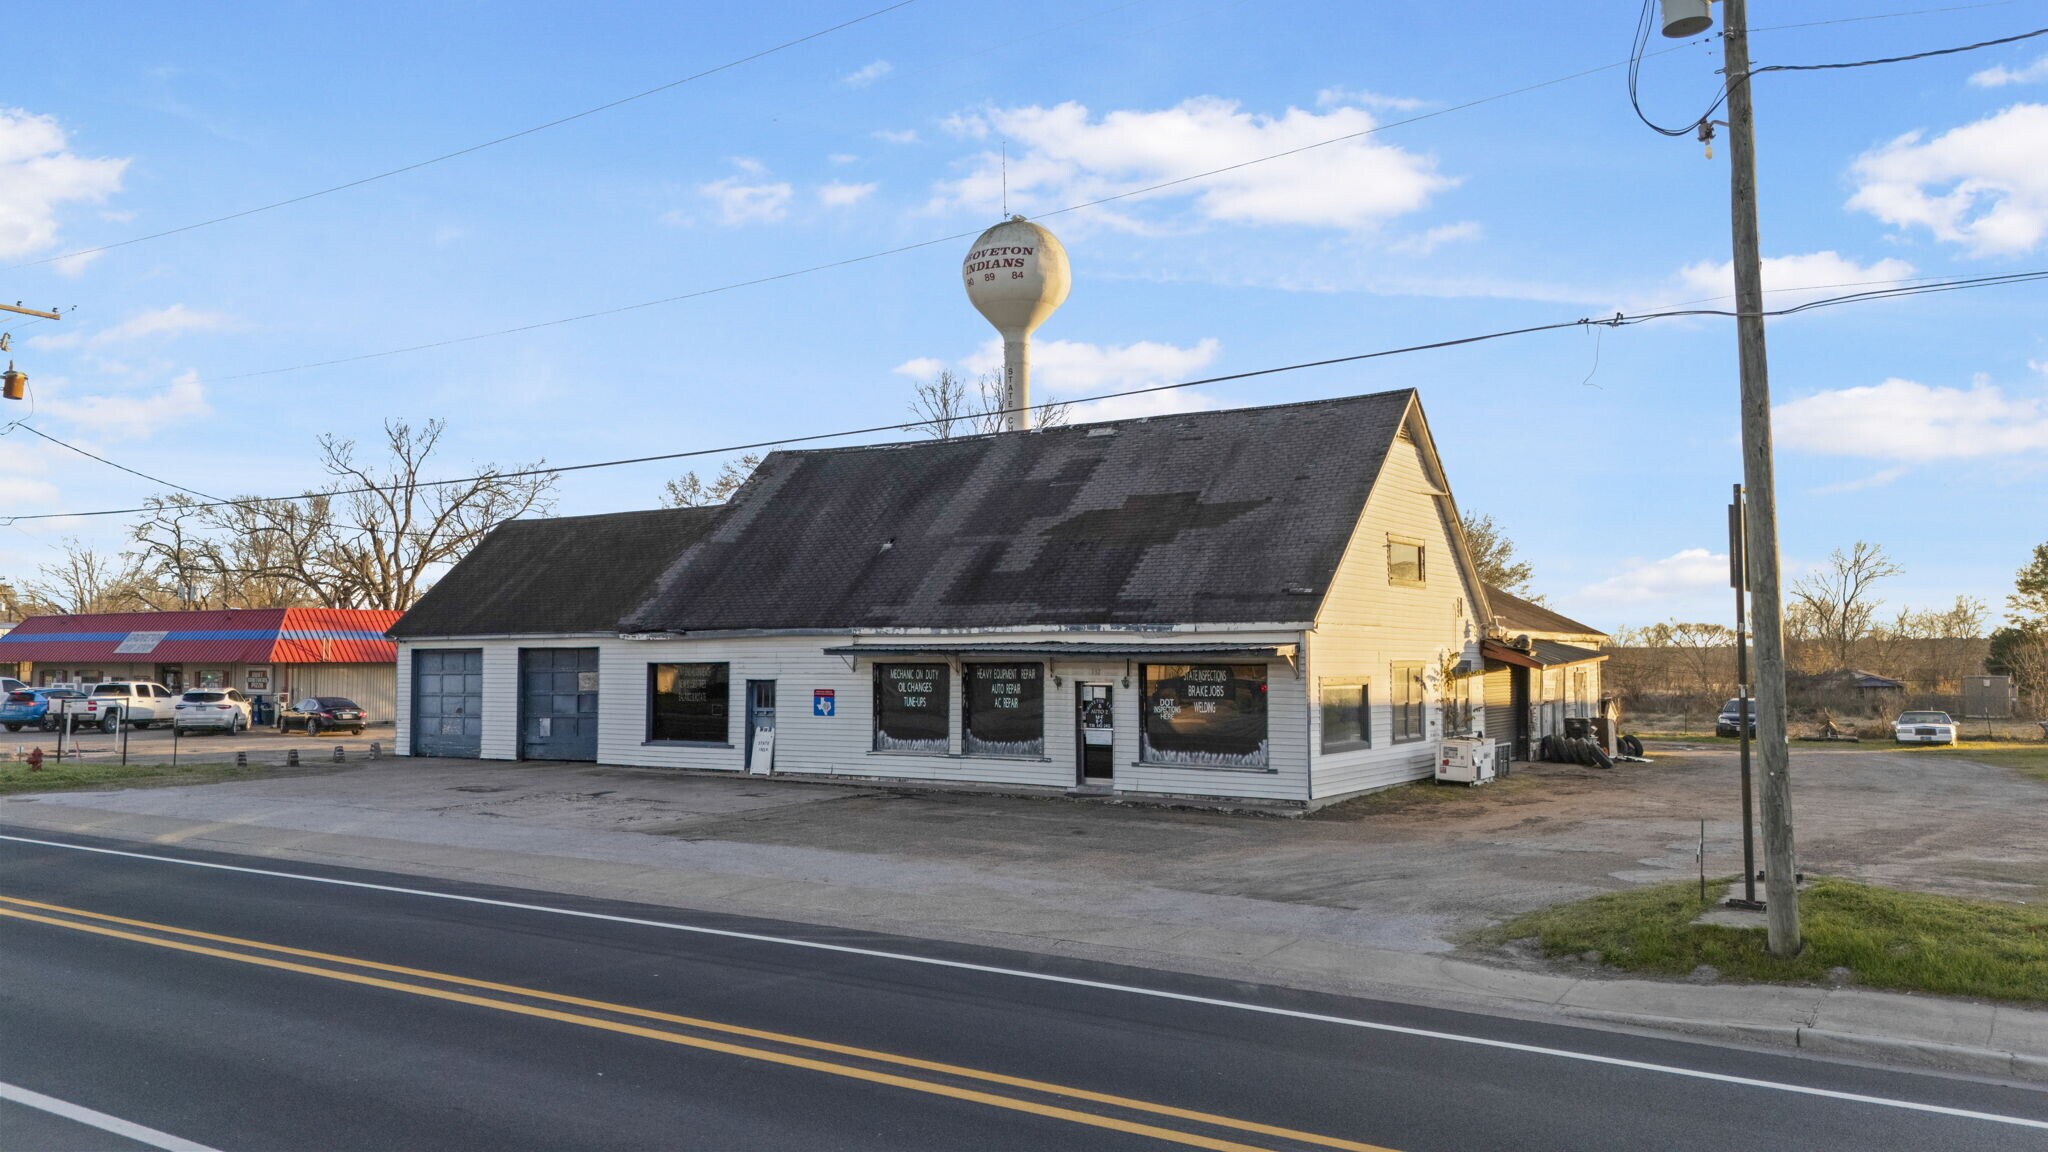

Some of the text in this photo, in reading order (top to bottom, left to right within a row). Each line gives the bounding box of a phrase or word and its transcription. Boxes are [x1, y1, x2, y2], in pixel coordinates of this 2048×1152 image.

[966, 258, 1025, 275] INDIANS
[984, 272, 996, 282] 89
[1011, 271, 1024, 280] 84
[890, 669, 940, 680] MECHANIC ON DUTY
[976, 668, 1036, 679] HEAVY EQUIPMENT REPAIR
[1198, 670, 1227, 682] INSPECTIONS
[898, 682, 933, 693] OIL CHANGES
[991, 683, 1021, 694] AUTO REPAIR
[1188, 685, 1225, 697] BRAKE JOBS
[903, 696, 927, 707] TUNE-UPS
[994, 697, 1019, 708] AC REPAIR
[1160, 698, 1175, 706] DOT
[1193, 701, 1216, 713] WELDING
[1153, 705, 1182, 714] INSPECTIONS
